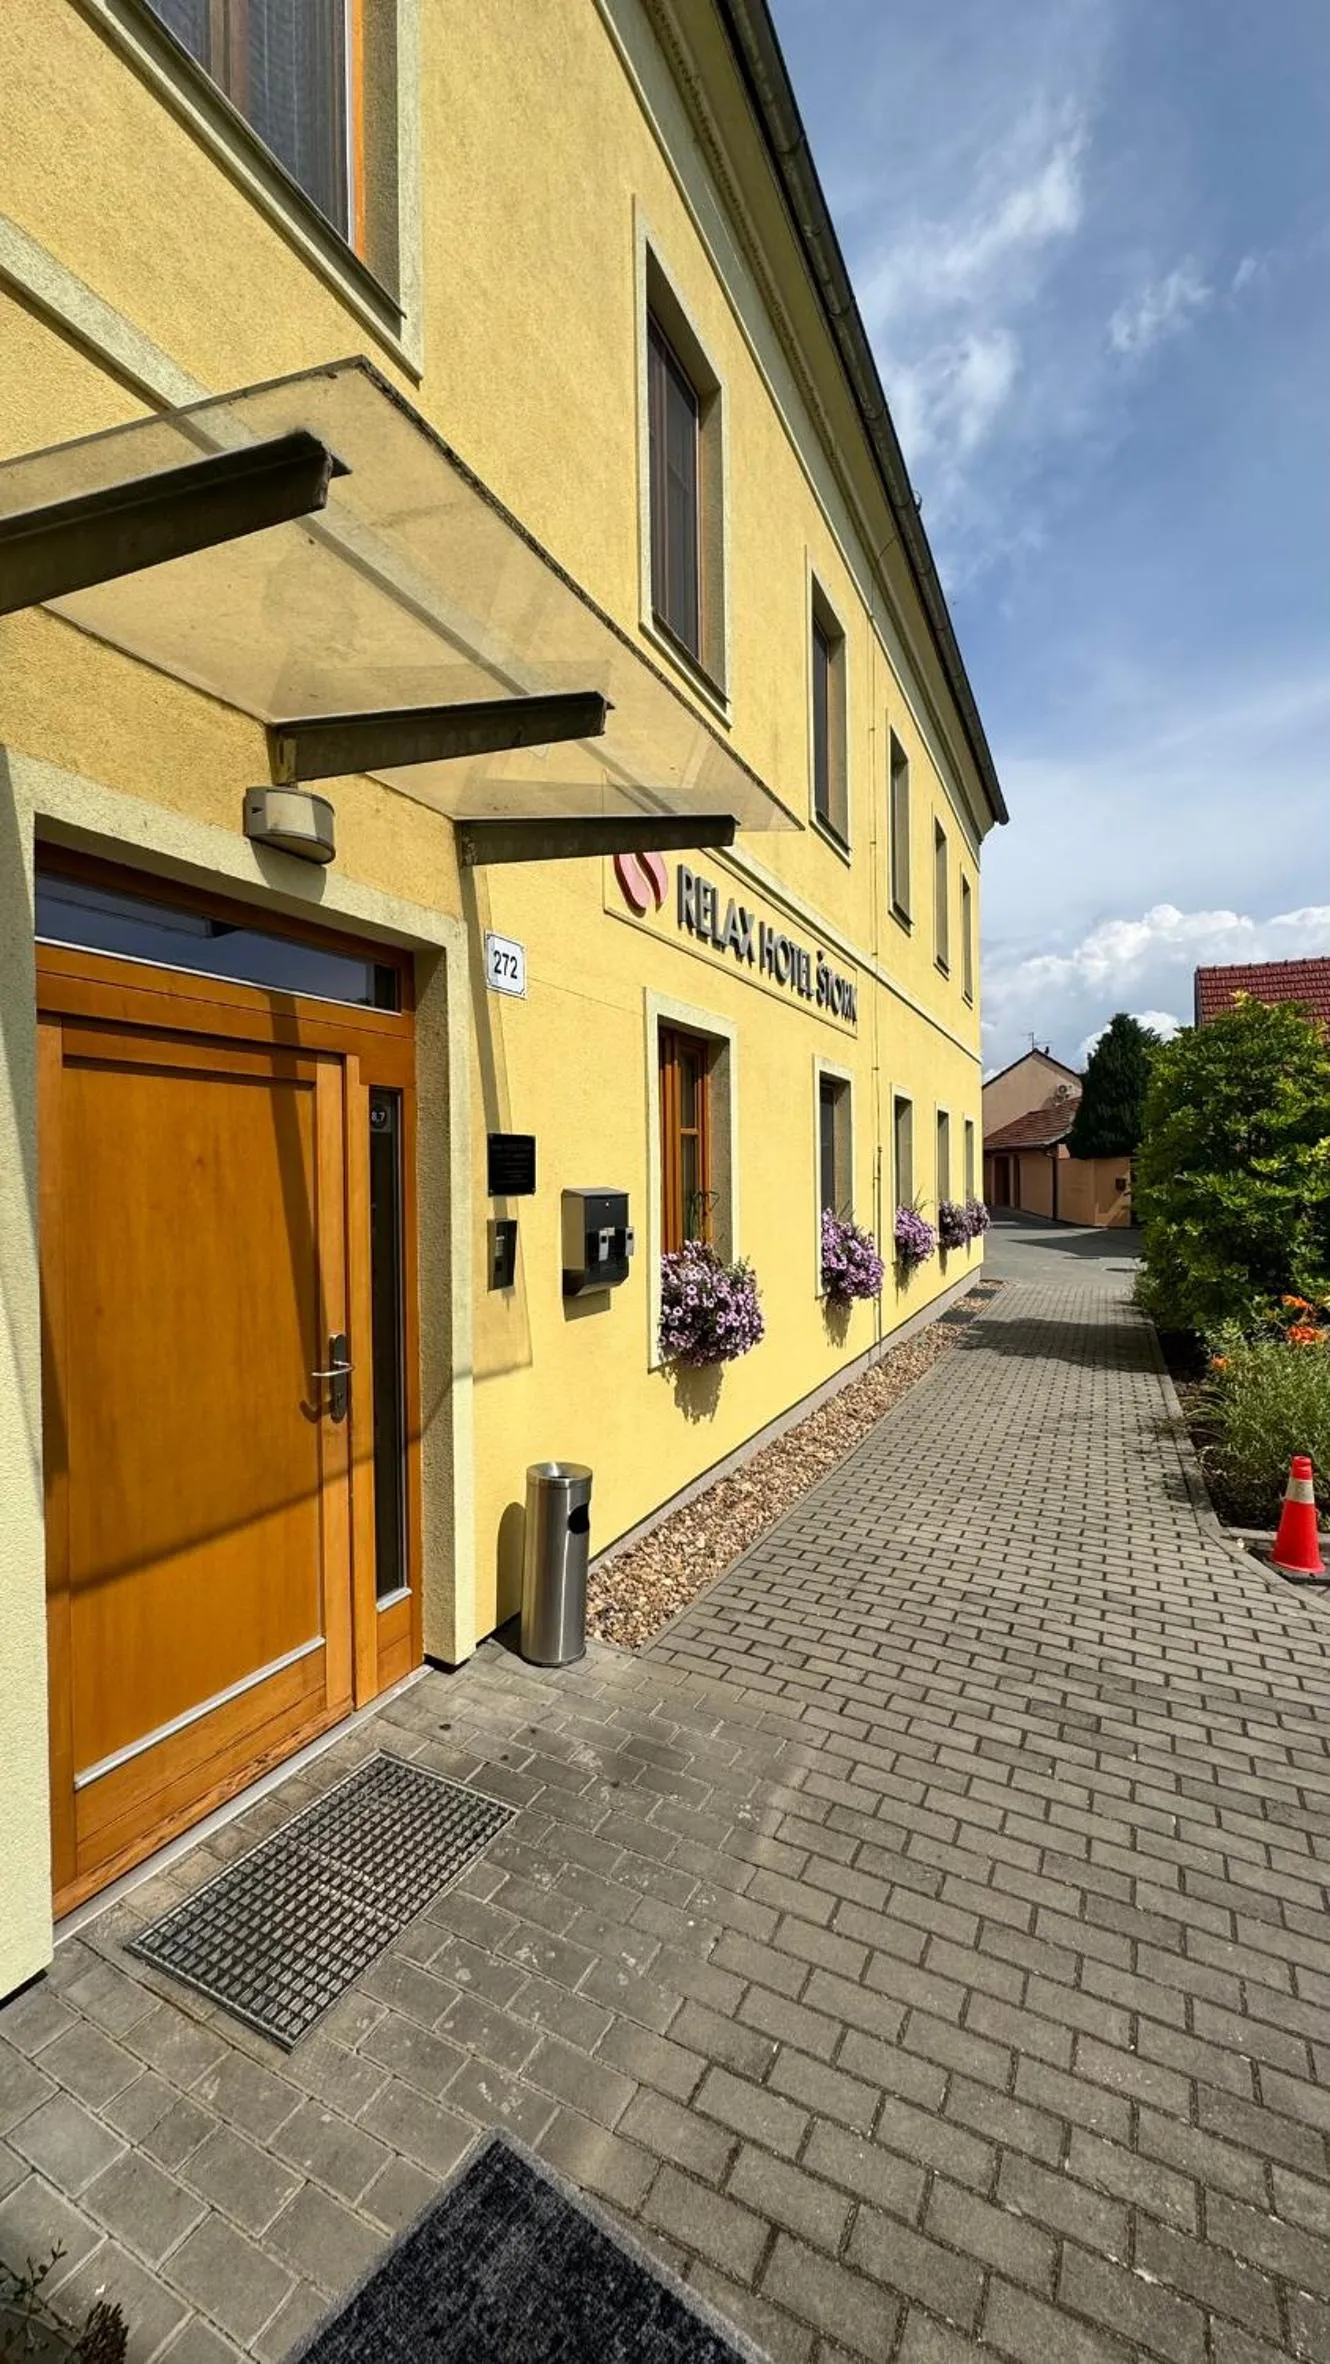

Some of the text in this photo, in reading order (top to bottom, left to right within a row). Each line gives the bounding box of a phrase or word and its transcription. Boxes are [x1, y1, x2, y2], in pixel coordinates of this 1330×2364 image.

[493, 949, 518, 979] 272
[677, 864, 857, 1024] RELAX HOTEL ŠTORK
